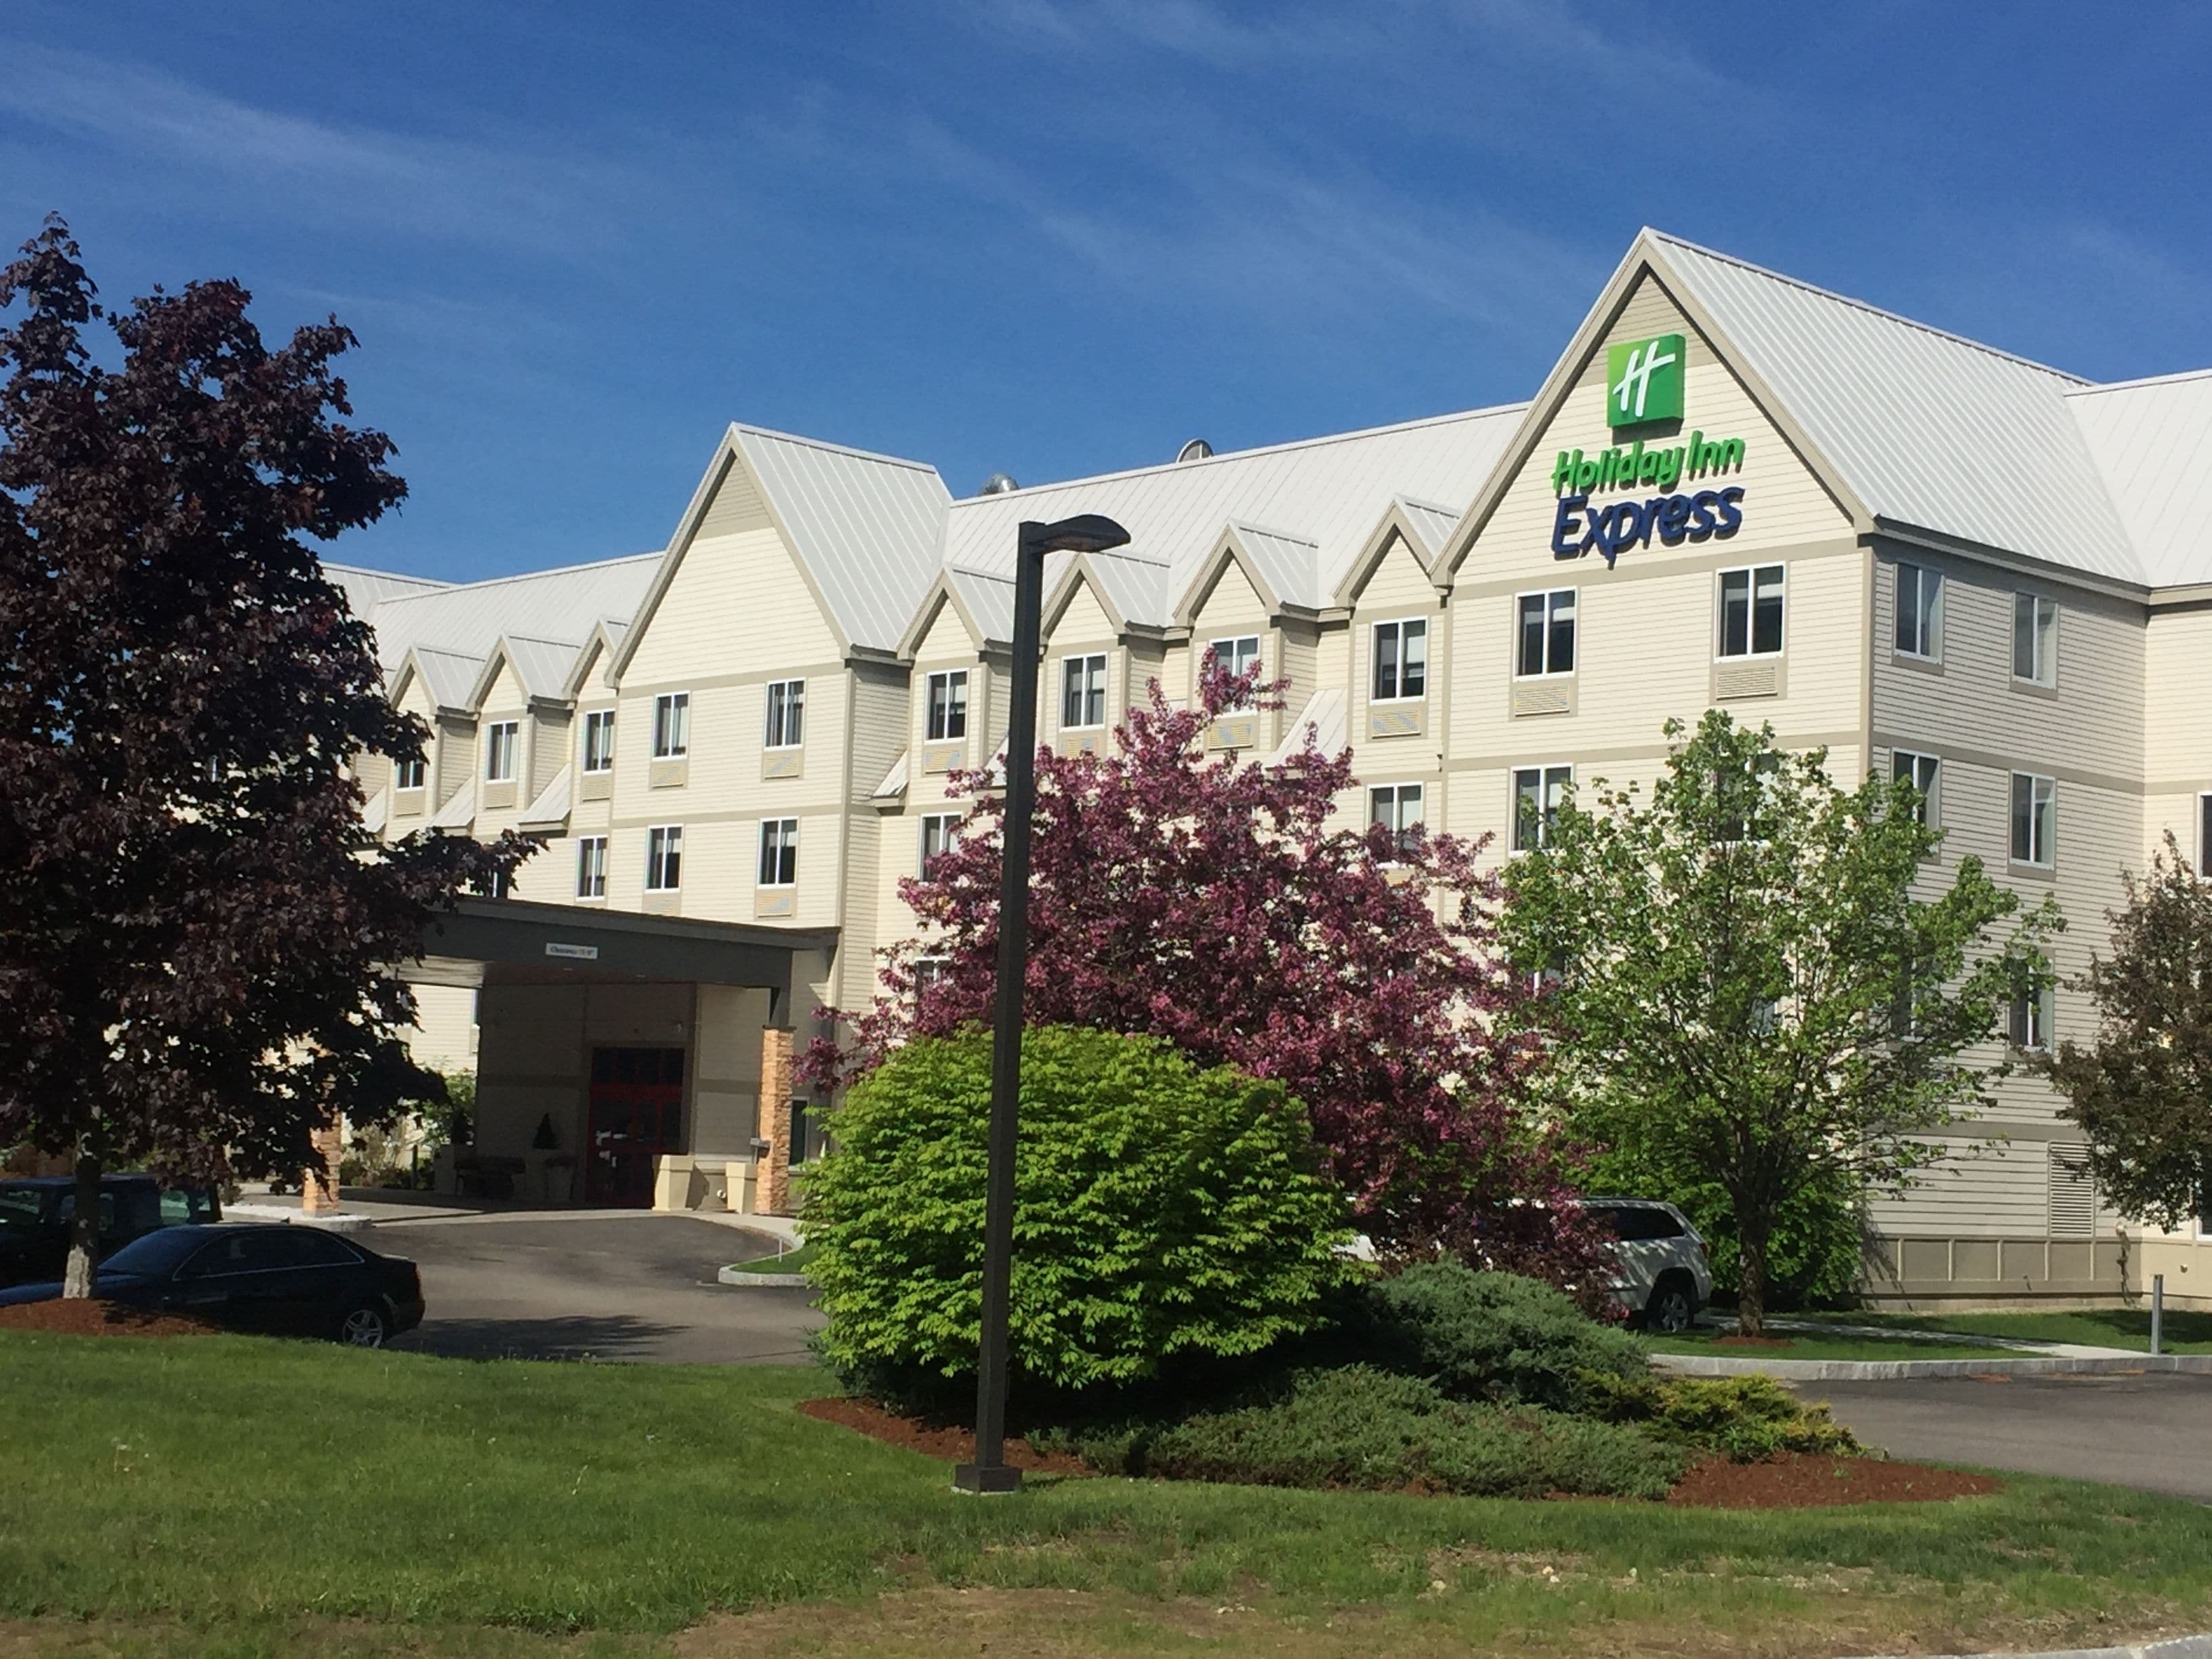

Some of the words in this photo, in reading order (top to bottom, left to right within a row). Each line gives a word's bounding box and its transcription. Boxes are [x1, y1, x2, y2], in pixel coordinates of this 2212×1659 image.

[1612, 340, 1676, 417] H
[1551, 441, 1685, 487] Holiday
[1686, 430, 1746, 474] Inn
[1551, 486, 1746, 569] Express
